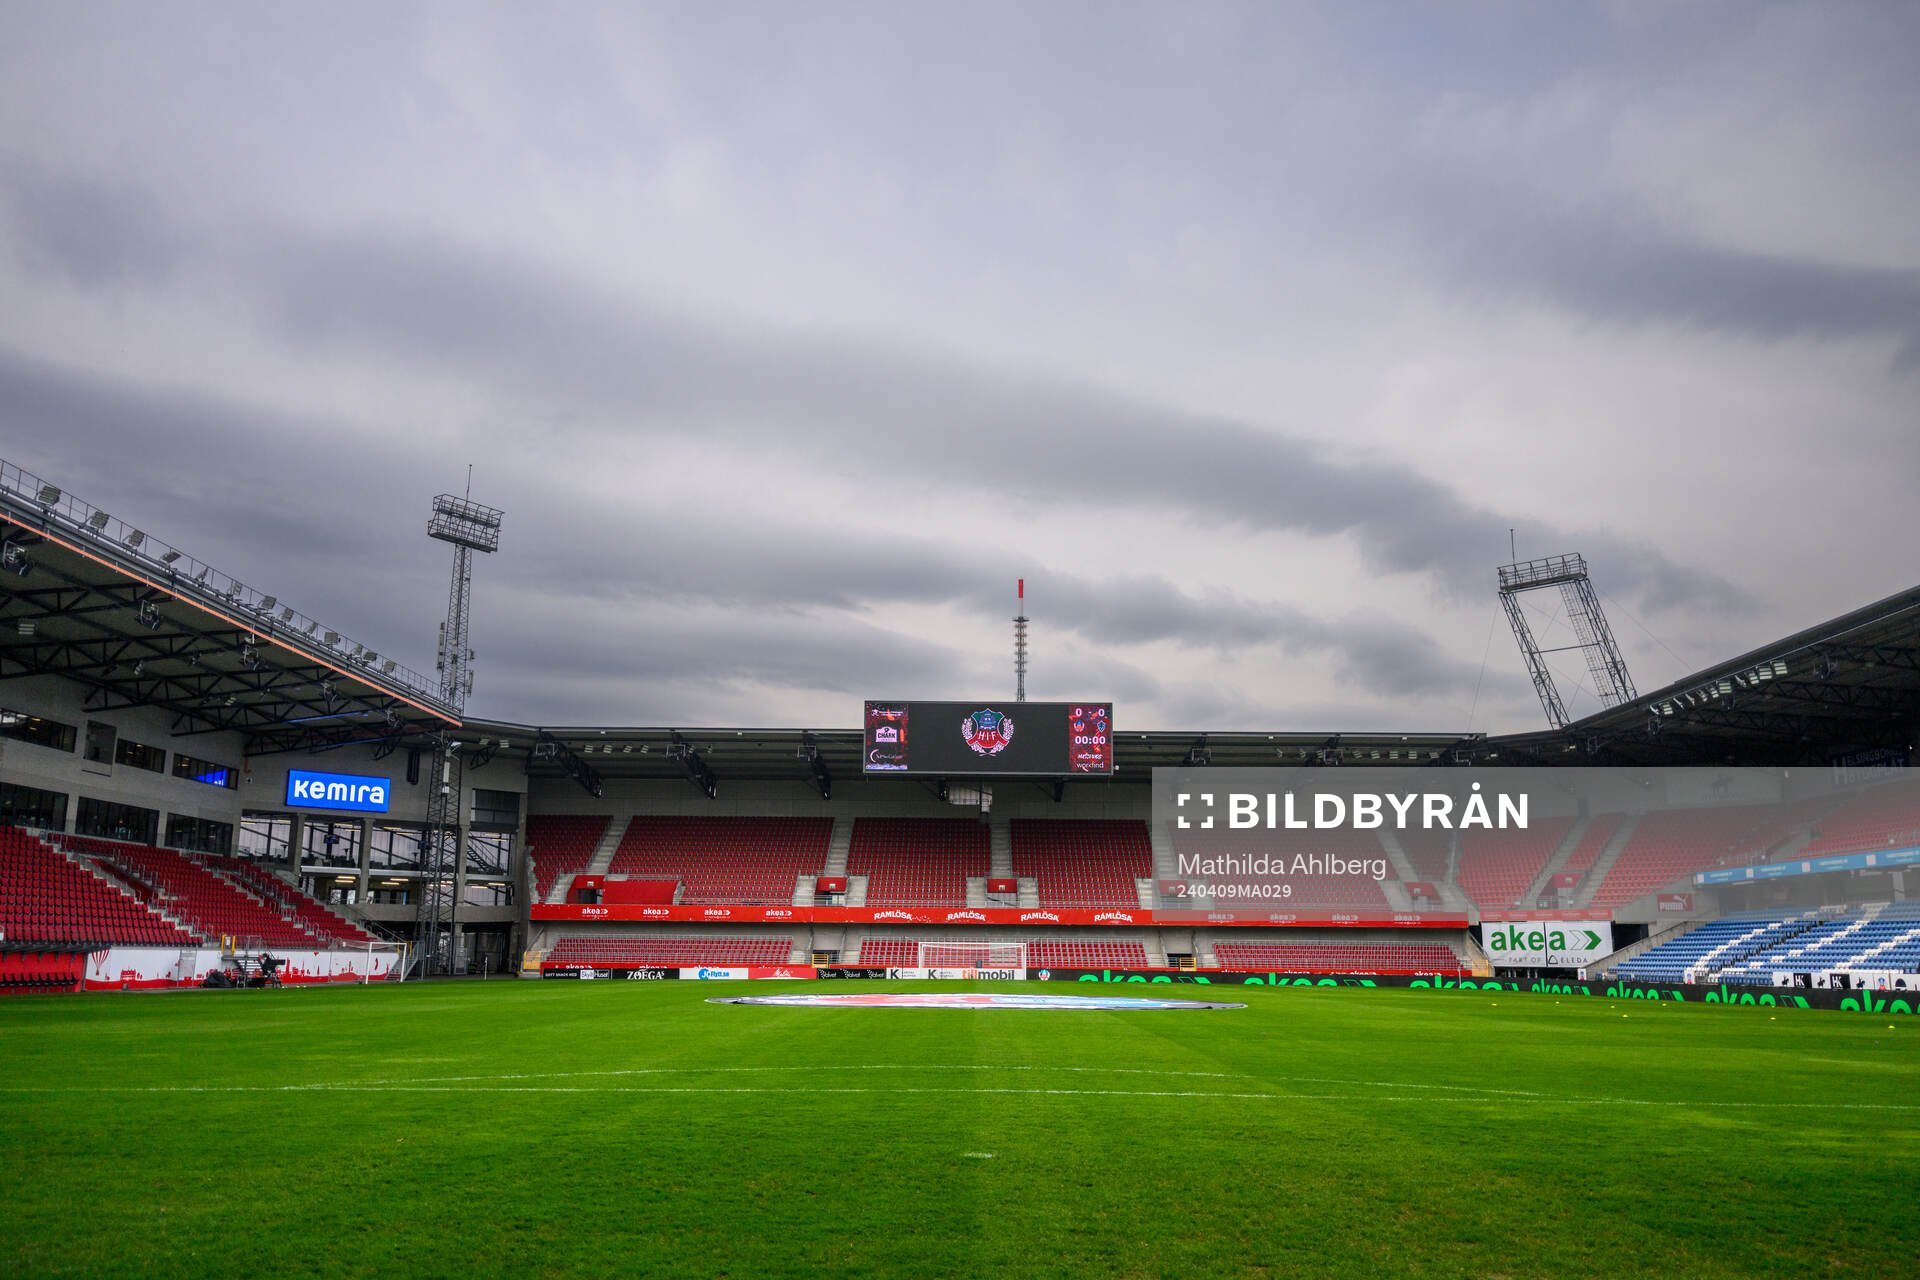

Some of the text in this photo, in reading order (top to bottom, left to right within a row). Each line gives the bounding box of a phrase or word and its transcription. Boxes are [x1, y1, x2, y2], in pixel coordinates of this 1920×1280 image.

[1075, 708, 1083, 717] 0
[1098, 708, 1105, 717] 0
[1074, 735, 1106, 745] 00:00
[874, 910, 913, 921] RAMLÖSA
[947, 910, 986, 921] RAMLÖSA
[1021, 910, 1060, 922] RAMLÖSA
[1093, 911, 1133, 923] RAMLÖSA
[1490, 924, 1567, 951] akea
